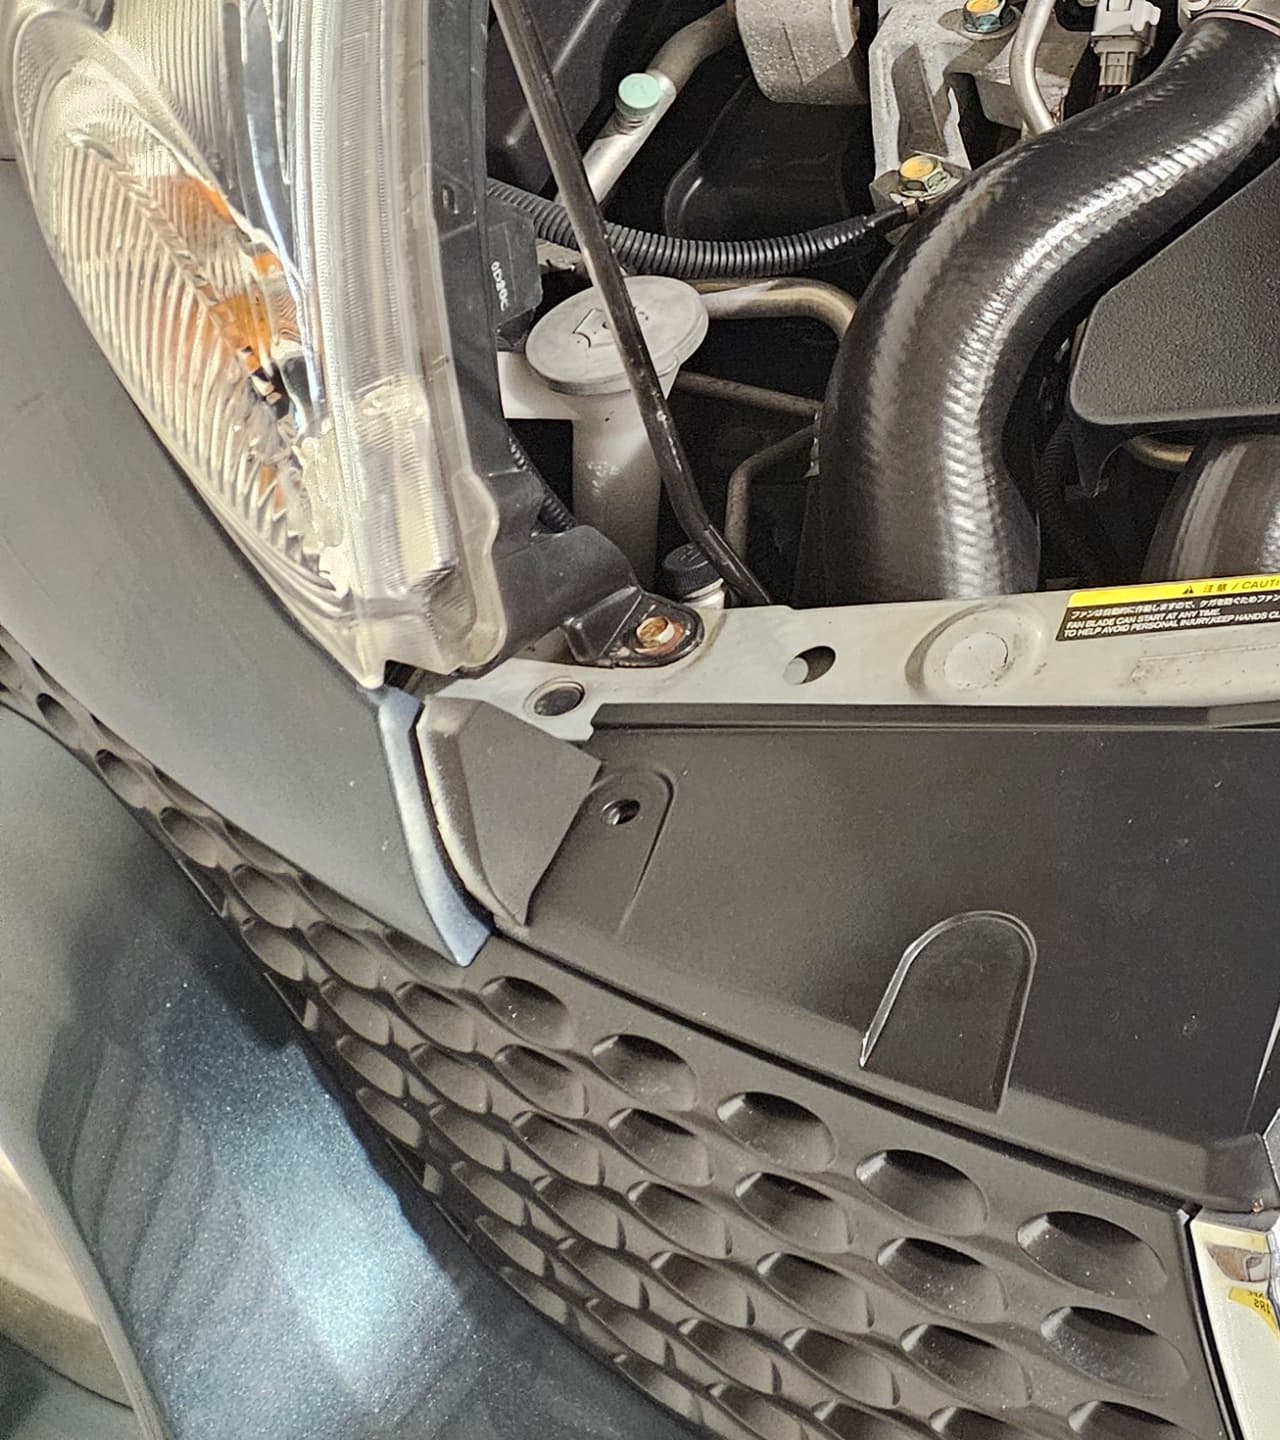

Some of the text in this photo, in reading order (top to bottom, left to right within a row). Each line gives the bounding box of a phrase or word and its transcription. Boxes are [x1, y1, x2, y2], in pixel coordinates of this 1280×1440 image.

[1064, 629, 1077, 638] TO
[1077, 626, 1103, 636] HELP
[1102, 624, 1129, 634] AVOID
[1130, 620, 1178, 632] PERSONAL
[1235, 611, 1267, 622] HANDS
[1066, 620, 1085, 629] FAN
[1085, 617, 1115, 627] BLADE
[1115, 615, 1136, 625] CAN
[1137, 613, 1167, 623] START
[1167, 612, 1178, 620] AT
[1178, 610, 1198, 619] ANY
